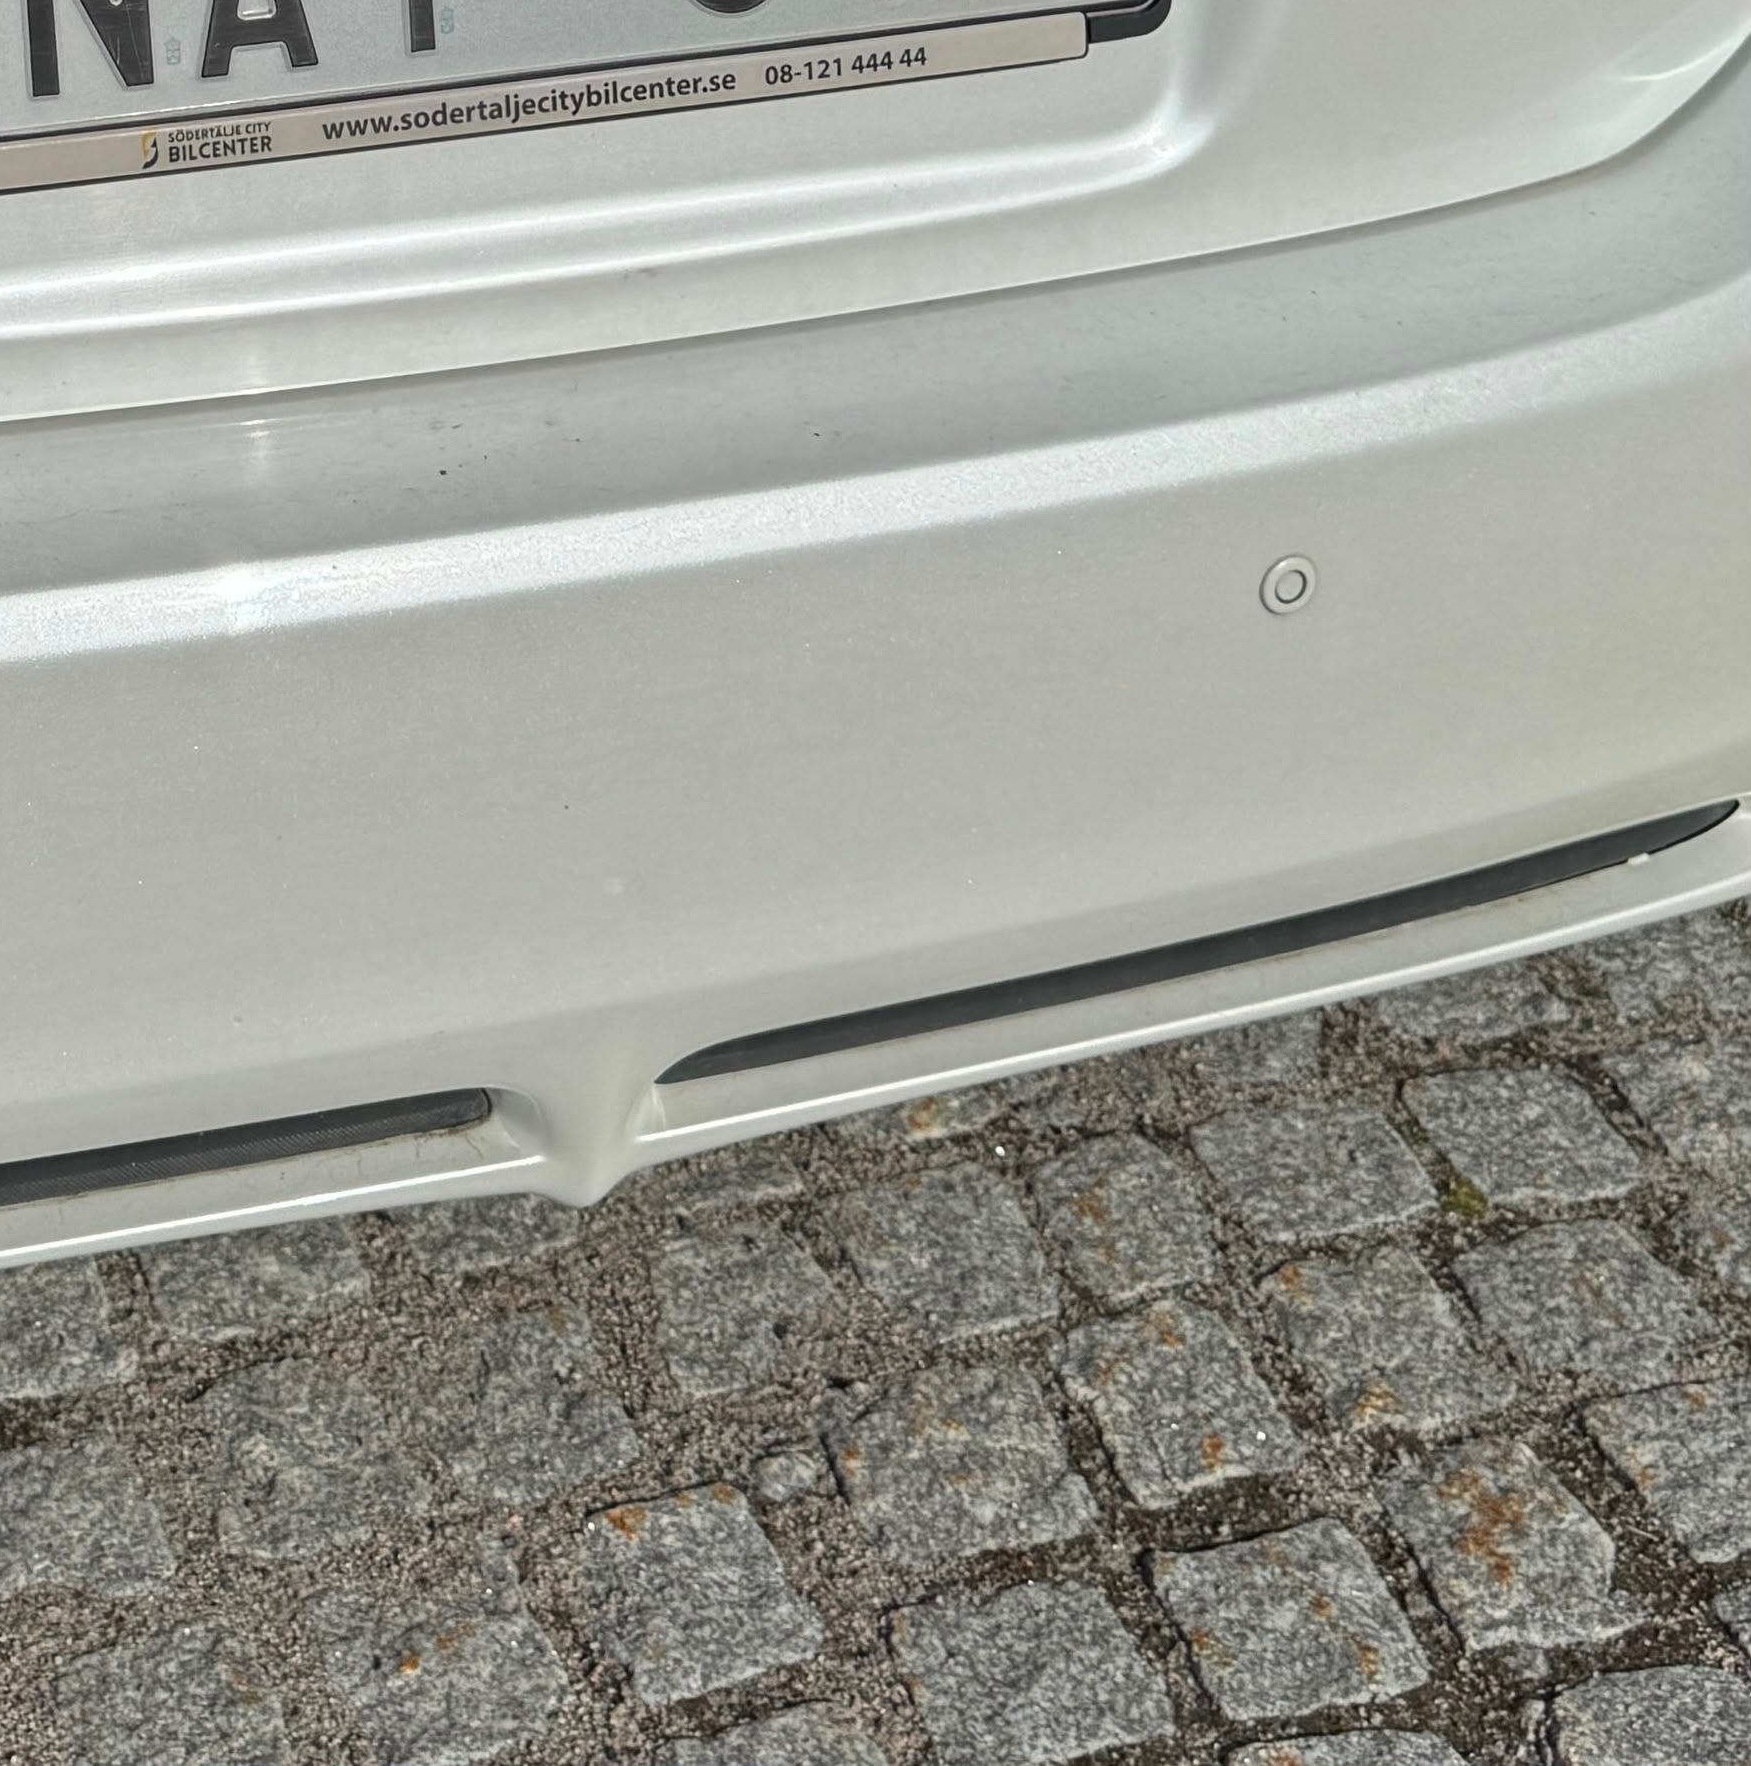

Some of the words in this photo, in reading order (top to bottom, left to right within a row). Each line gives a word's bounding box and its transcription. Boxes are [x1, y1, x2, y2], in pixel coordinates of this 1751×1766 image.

[322, 70, 736, 141] www.sodertaljecitybilcenter.se
[765, 58, 842, 85] 08-121
[851, 51, 893, 74] 444
[899, 47, 927, 68] 44
[168, 125, 241, 143] SÖDERTÄLJE
[245, 121, 271, 135] CITY
[169, 135, 272, 162] BILCENTER
